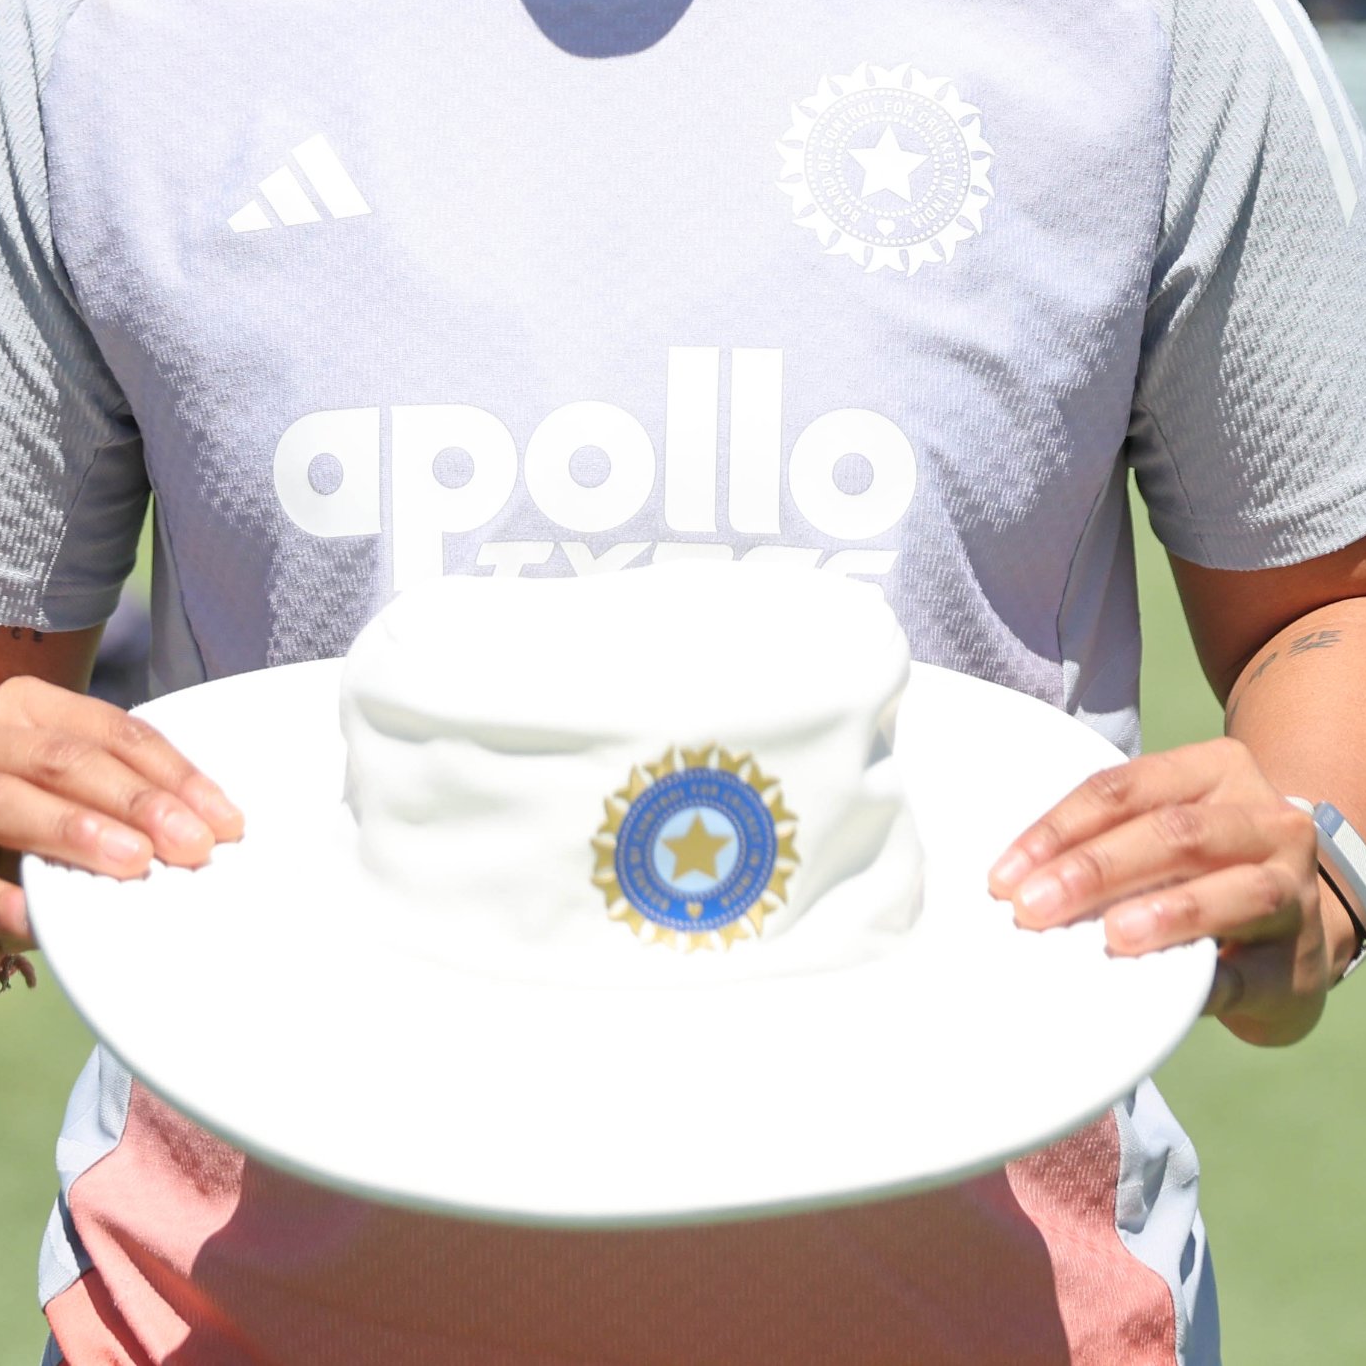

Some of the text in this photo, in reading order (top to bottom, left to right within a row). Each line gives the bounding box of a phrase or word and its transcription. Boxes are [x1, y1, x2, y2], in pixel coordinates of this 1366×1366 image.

[818, 101, 958, 228] BOARD OF CONTROL FOR CRICKET IN INDIA
[273, 346, 918, 593] apollo
